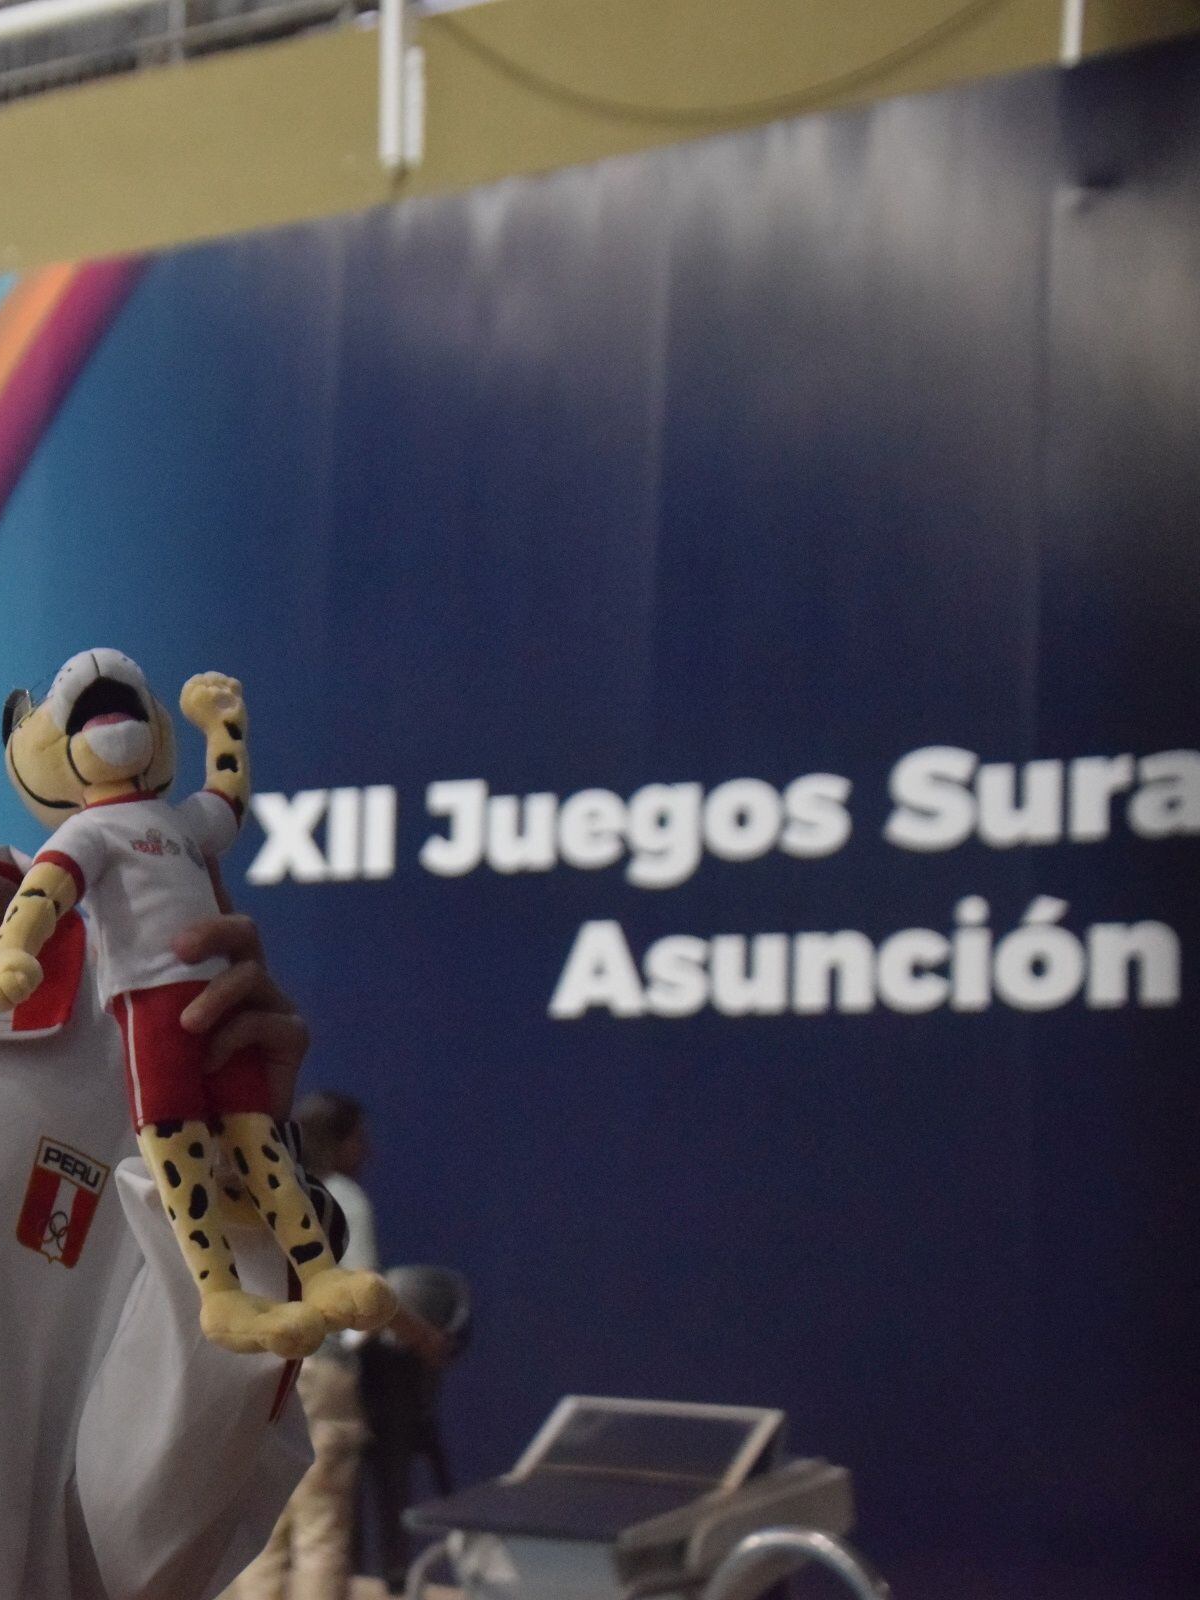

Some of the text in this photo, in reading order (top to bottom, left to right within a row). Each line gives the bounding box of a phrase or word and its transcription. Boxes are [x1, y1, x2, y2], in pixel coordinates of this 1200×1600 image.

[246, 784, 397, 886] XII
[419, 773, 853, 890] Juegos
[548, 895, 1181, 1021] Asunción
[43, 1147, 100, 1188] PERU
